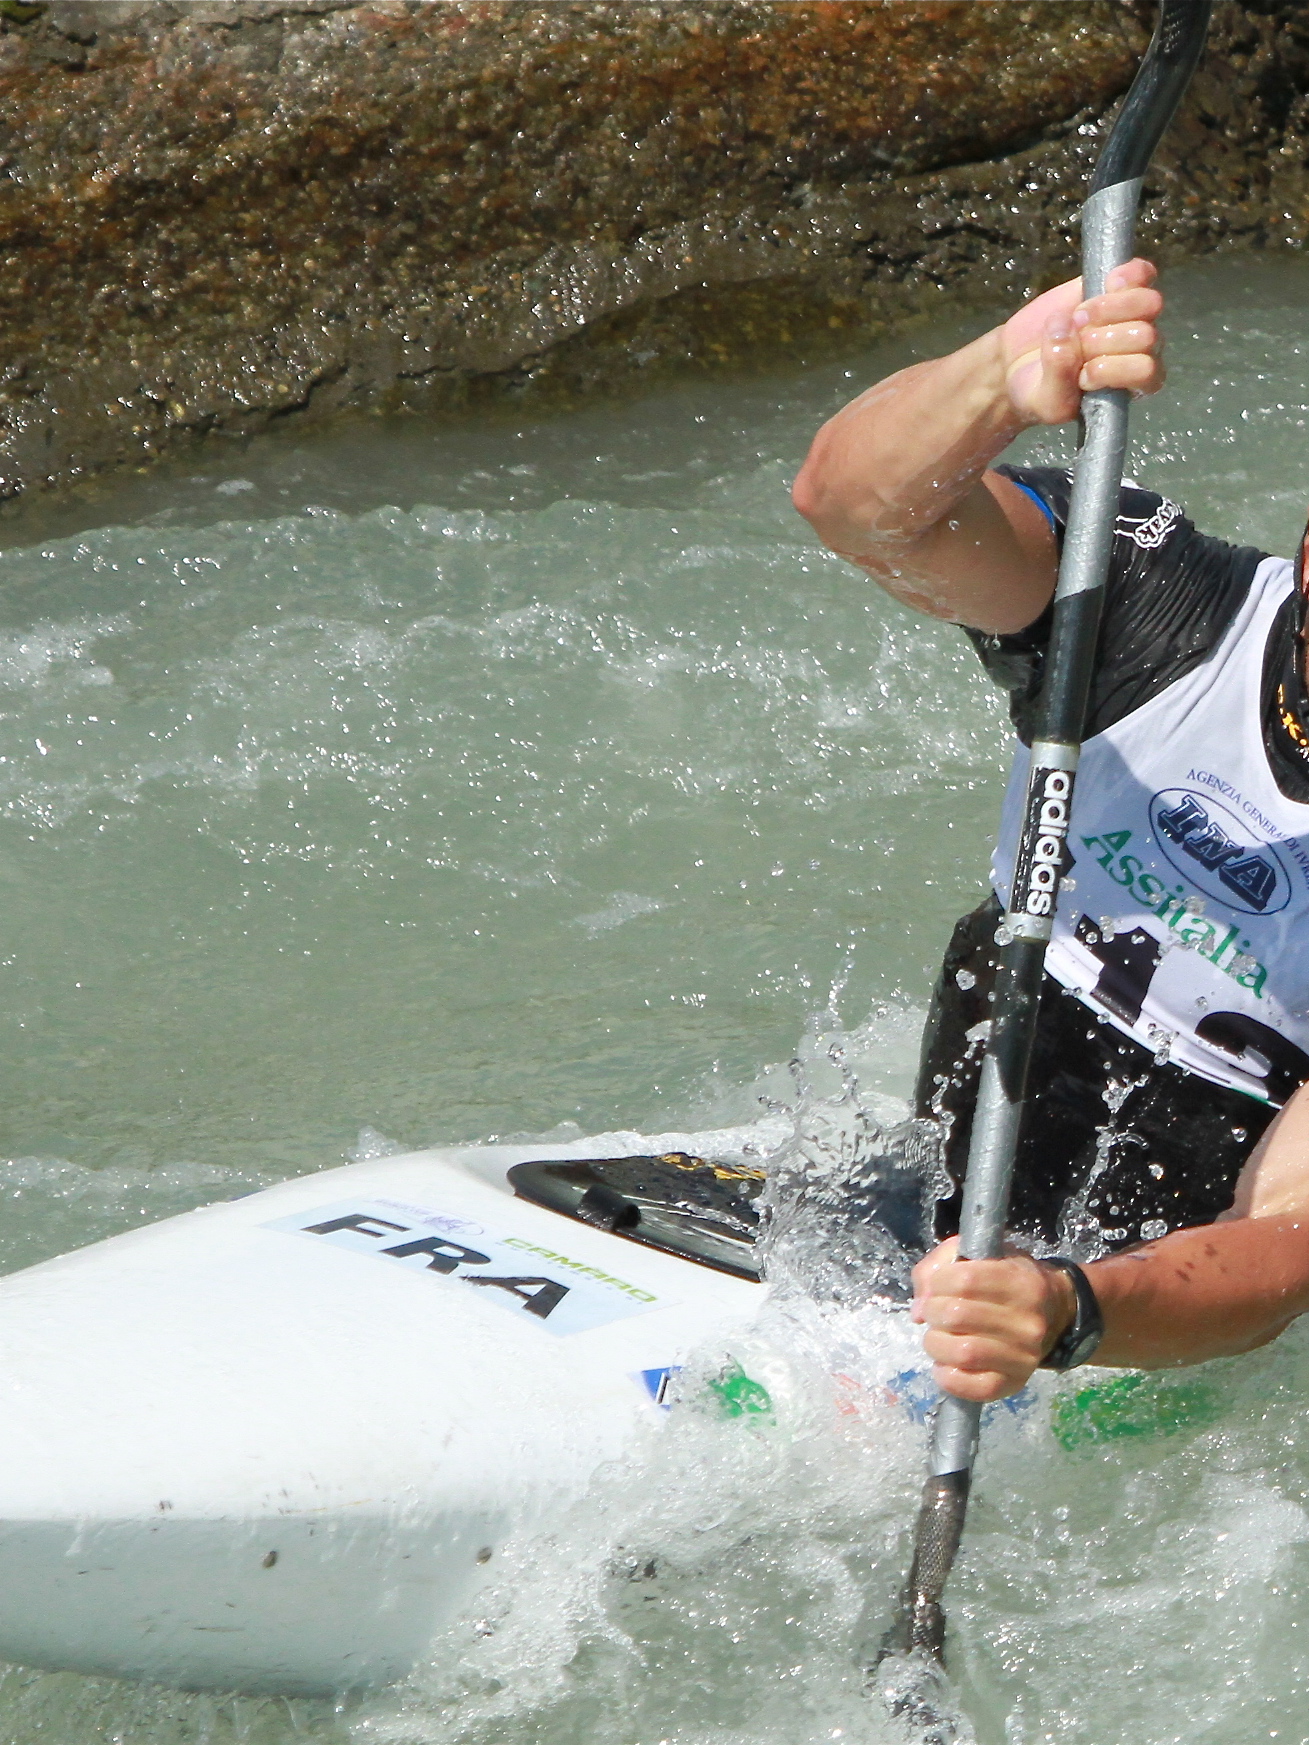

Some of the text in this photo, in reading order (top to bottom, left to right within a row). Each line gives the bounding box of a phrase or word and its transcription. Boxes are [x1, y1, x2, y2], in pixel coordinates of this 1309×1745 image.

[1026, 771, 1070, 915] adidas
[1157, 794, 1277, 912] INA
[1186, 769, 1242, 805] AGENZIA
[1283, 837, 1300, 852] DI
[1080, 829, 1269, 999] Assitalia
[300, 1214, 570, 1320] FRA
